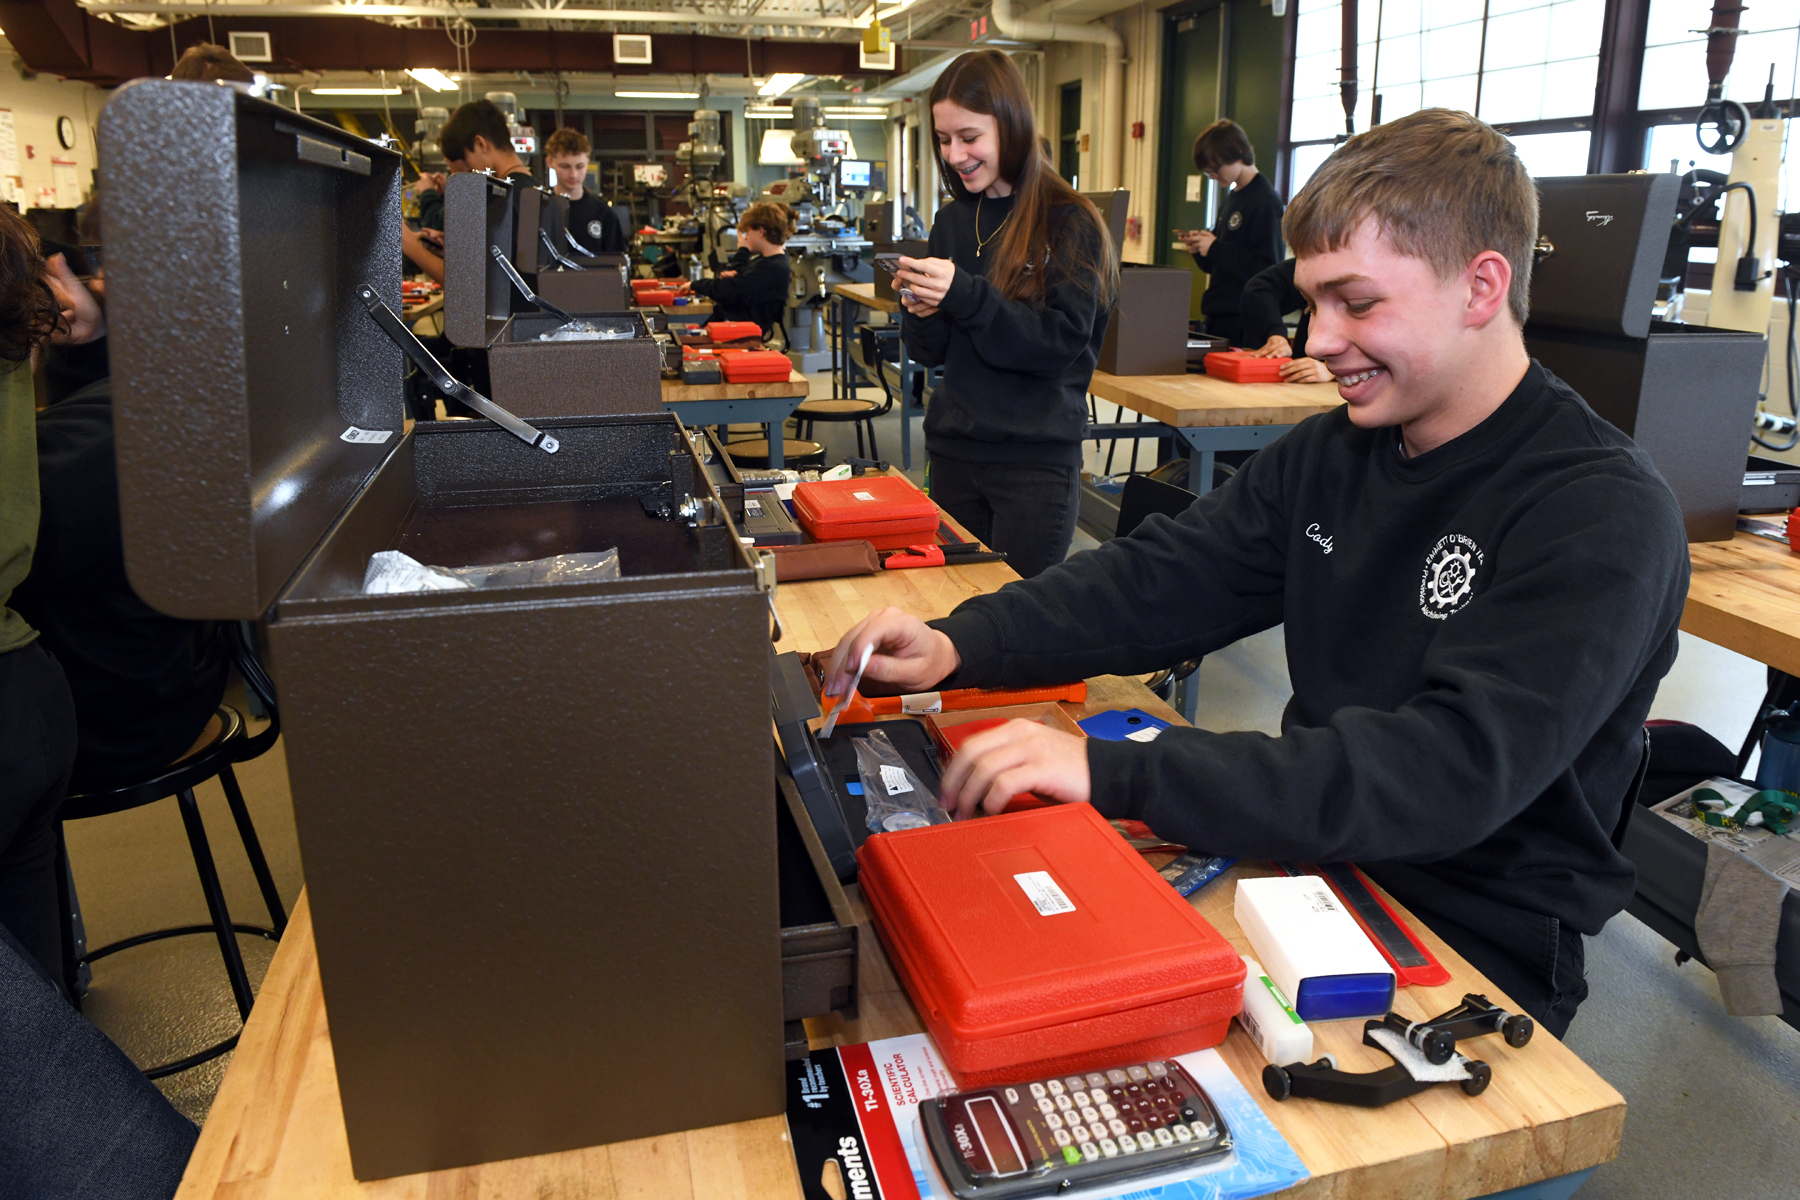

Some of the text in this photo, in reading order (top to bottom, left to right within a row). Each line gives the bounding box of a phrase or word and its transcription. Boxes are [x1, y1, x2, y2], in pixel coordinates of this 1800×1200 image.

[1305, 523, 1333, 554] Cody
[1425, 535, 1448, 564] EMMETT
[1449, 533, 1477, 552] O'BRIEN
[798, 1077, 810, 1094] Brand
[801, 1058, 818, 1093] recommended
[814, 1064, 830, 1093] by teachers
[857, 1069, 879, 1112] TI-30Xa
[884, 1062, 906, 1106] SCIENTIFIC
[893, 1053, 918, 1104] CALCULATOR
[802, 1093, 830, 1108] #1
[953, 1123, 976, 1160] TI-30Xa
